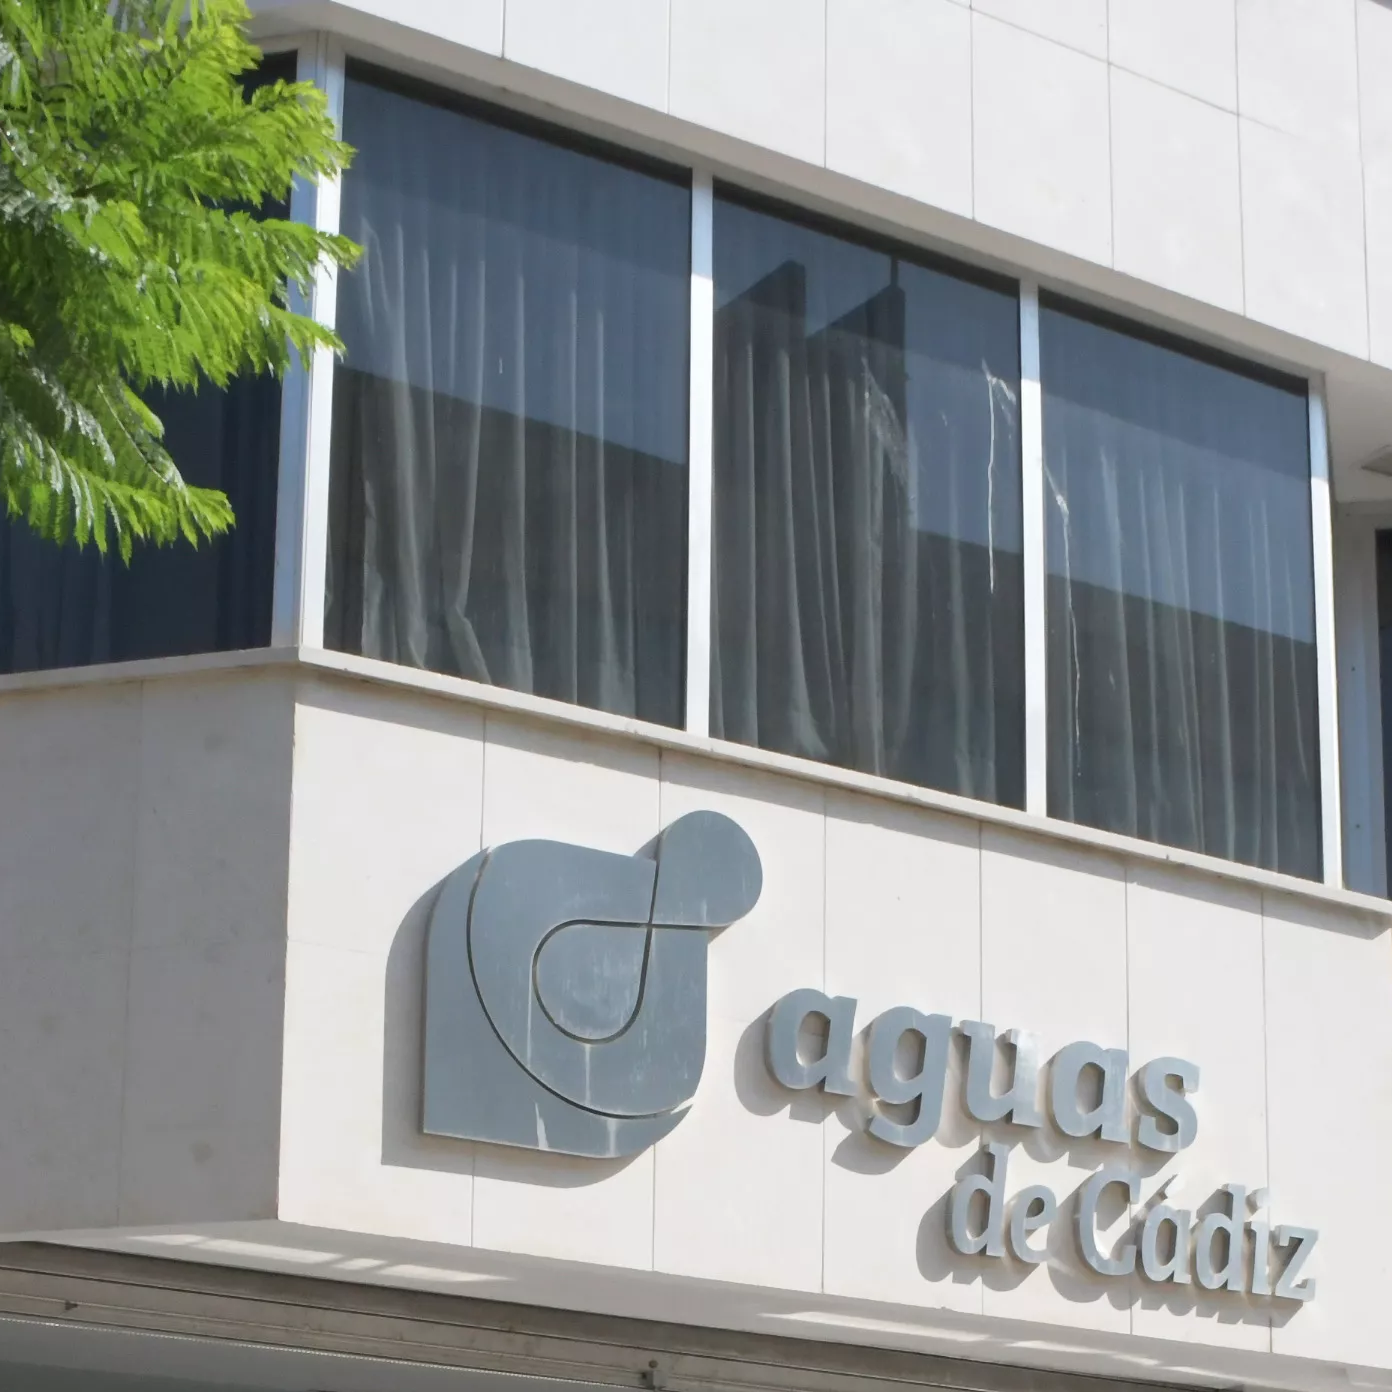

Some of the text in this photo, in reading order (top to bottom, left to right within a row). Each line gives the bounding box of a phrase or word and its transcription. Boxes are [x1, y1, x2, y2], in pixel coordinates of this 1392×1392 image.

[766, 988, 1200, 1152] aguas
[948, 1143, 1317, 1302] de Cádiz
